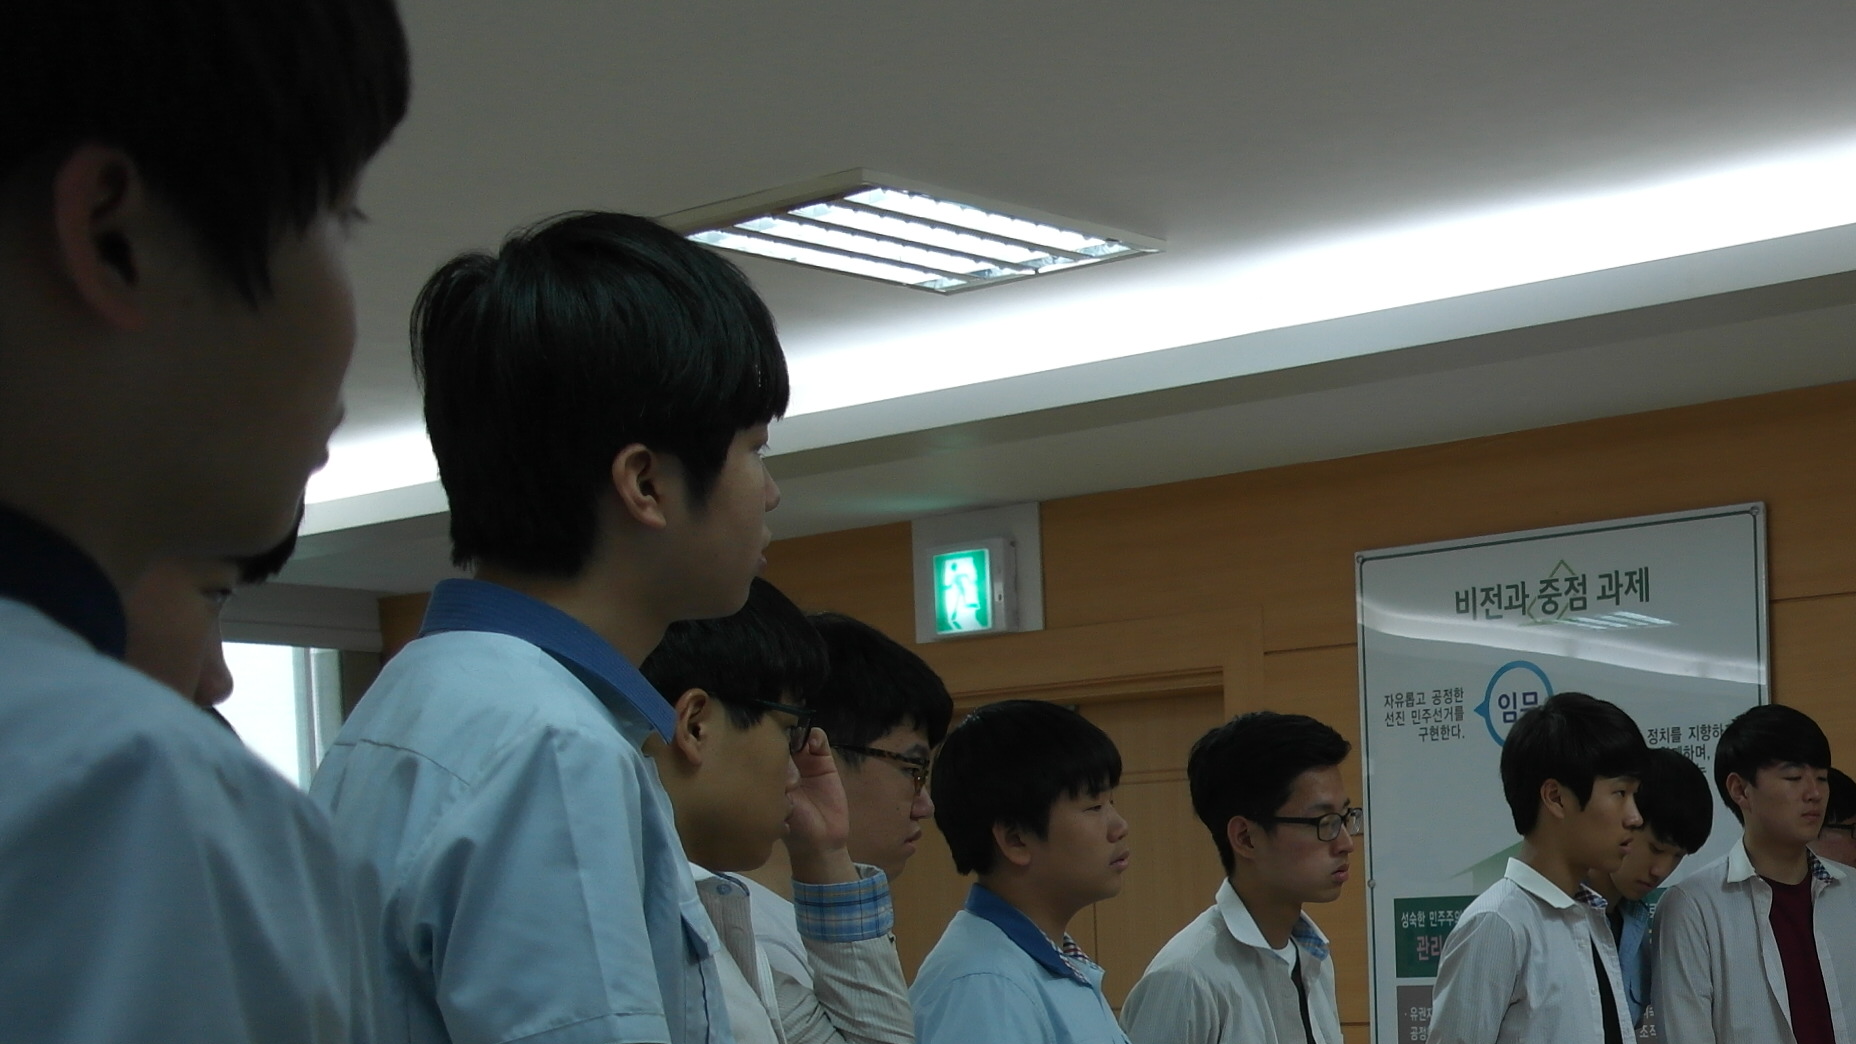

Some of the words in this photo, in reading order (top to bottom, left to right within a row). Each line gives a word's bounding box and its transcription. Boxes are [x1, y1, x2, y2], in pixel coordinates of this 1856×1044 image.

[1455, 581, 1529, 620] 비전과
[1538, 574, 1587, 615] 중점
[1597, 567, 1650, 605] 과제
[1384, 692, 1426, 709] 자유롭고
[1431, 687, 1465, 706] 공정한
[1384, 711, 1405, 727] 선진
[1411, 705, 1465, 725] 민주선거를
[1418, 724, 1465, 742] 구현한다.
[1648, 726, 1682, 745] 정치를
[1688, 723, 1730, 742] 지향하
[1401, 910, 1426, 929] 성숙한
